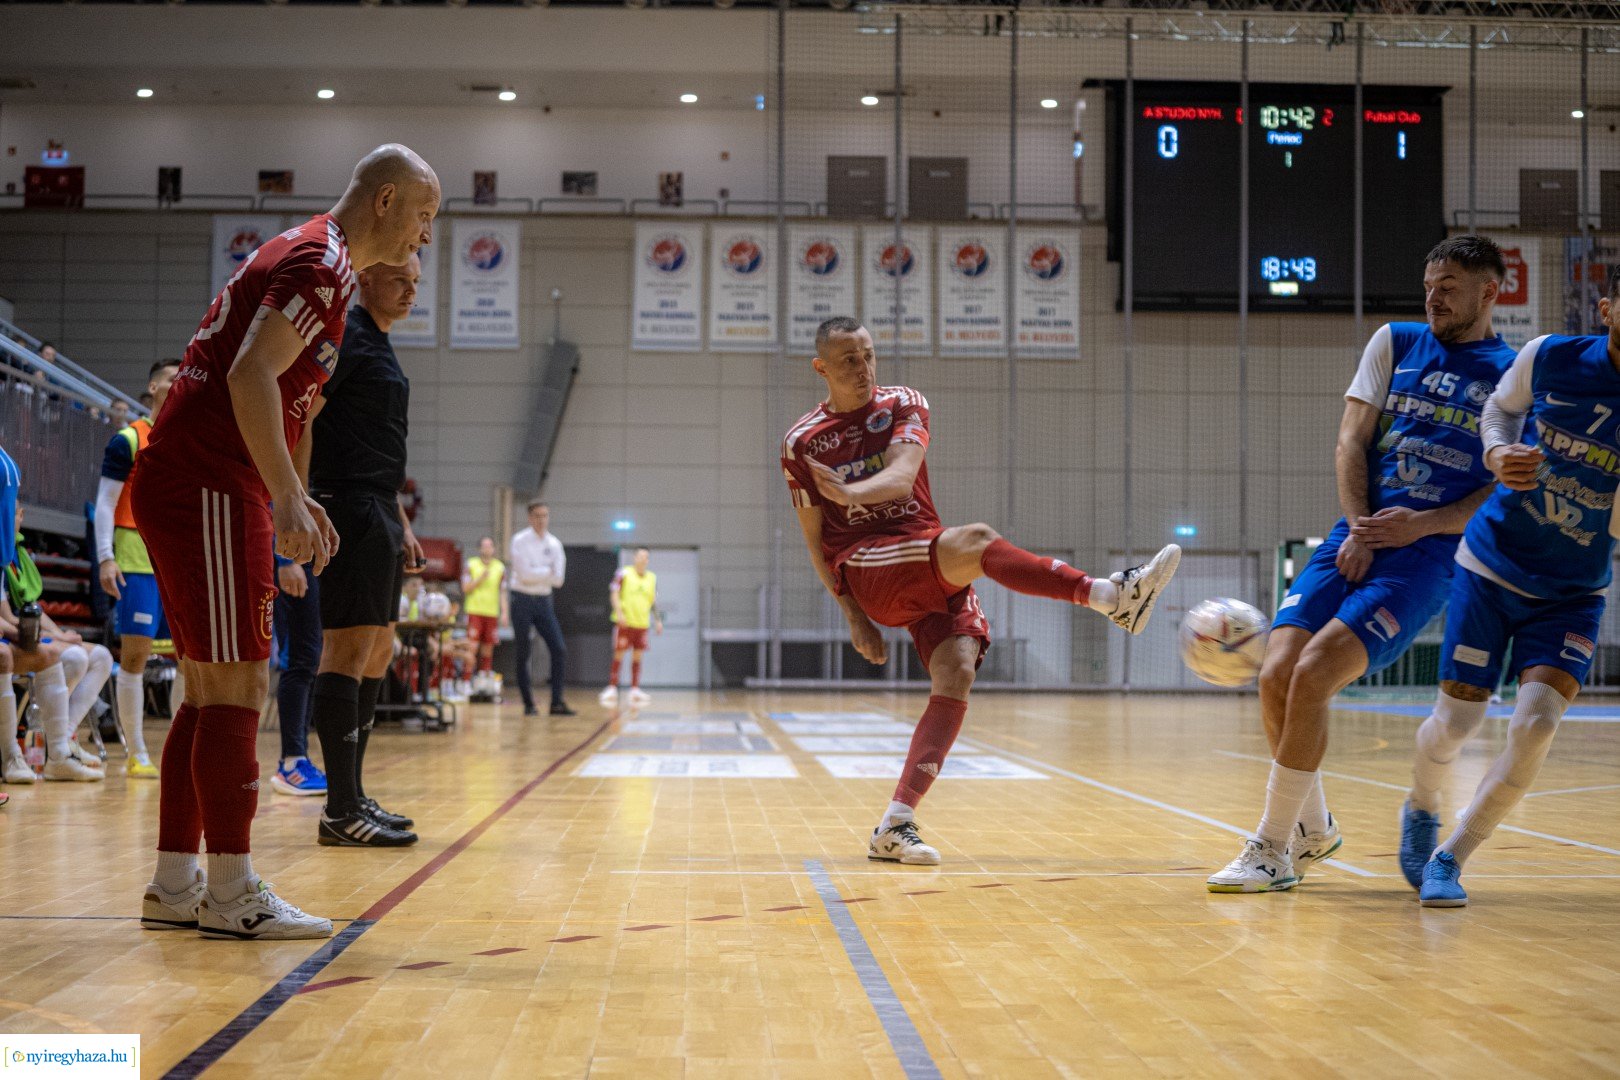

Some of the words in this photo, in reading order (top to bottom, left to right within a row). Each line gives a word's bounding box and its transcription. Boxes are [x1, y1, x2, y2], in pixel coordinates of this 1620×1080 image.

[1260, 105, 1316, 130] 10:42
[1321, 108, 1334, 127] 2
[1396, 110, 1422, 124] Club
[1158, 125, 1178, 158] 0
[1397, 130, 1406, 160] 1
[1284, 151, 1293, 168] 1
[1422, 371, 1461, 397] 45
[1586, 403, 1613, 435] 7
[808, 431, 840, 457] 383
